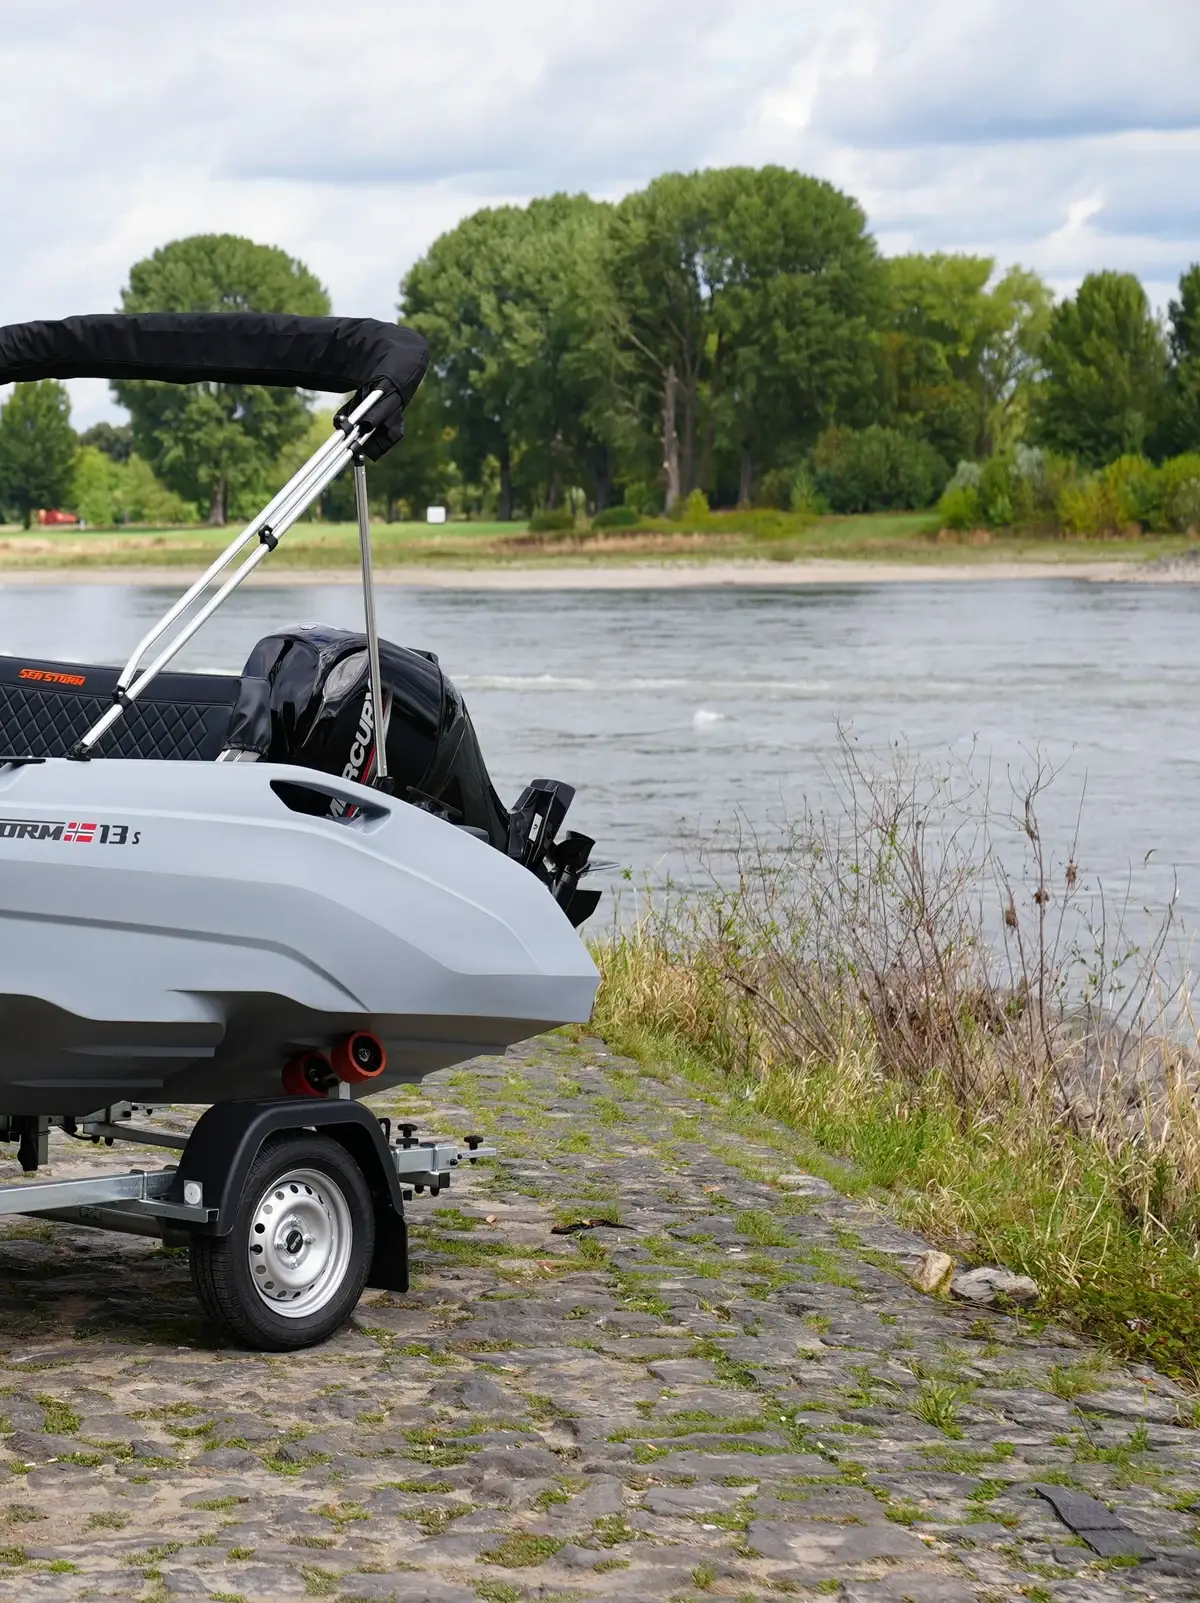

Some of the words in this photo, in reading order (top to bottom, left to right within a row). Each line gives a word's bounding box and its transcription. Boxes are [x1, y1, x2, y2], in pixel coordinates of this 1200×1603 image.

[17, 668, 43, 680] SEA
[42, 672, 87, 686] STORM
[99, 824, 129, 845] 13
